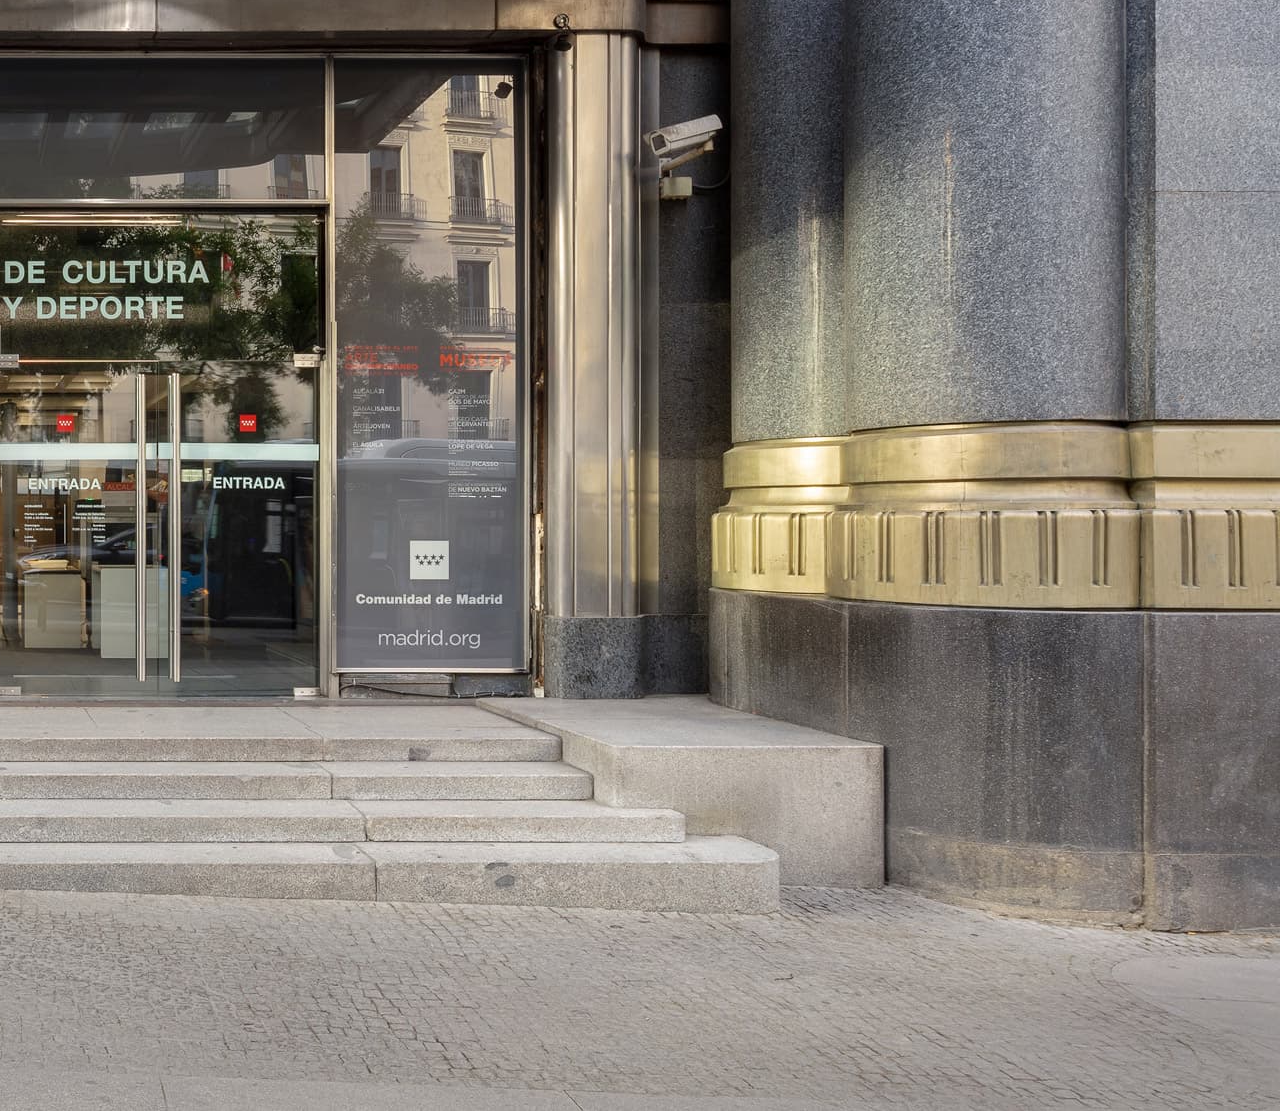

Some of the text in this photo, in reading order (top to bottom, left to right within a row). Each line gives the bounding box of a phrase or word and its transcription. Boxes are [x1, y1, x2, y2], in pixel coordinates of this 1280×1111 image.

[4, 260, 46, 284] DE
[62, 260, 210, 284] CULTURA
[2, 296, 24, 319] Y
[36, 295, 184, 320] DEPORTE
[28, 477, 102, 490] ENTRADA
[213, 477, 286, 489] ENTRADA
[355, 593, 503, 605] Comunidad de Madrid
[378, 630, 481, 649] madrid.org
